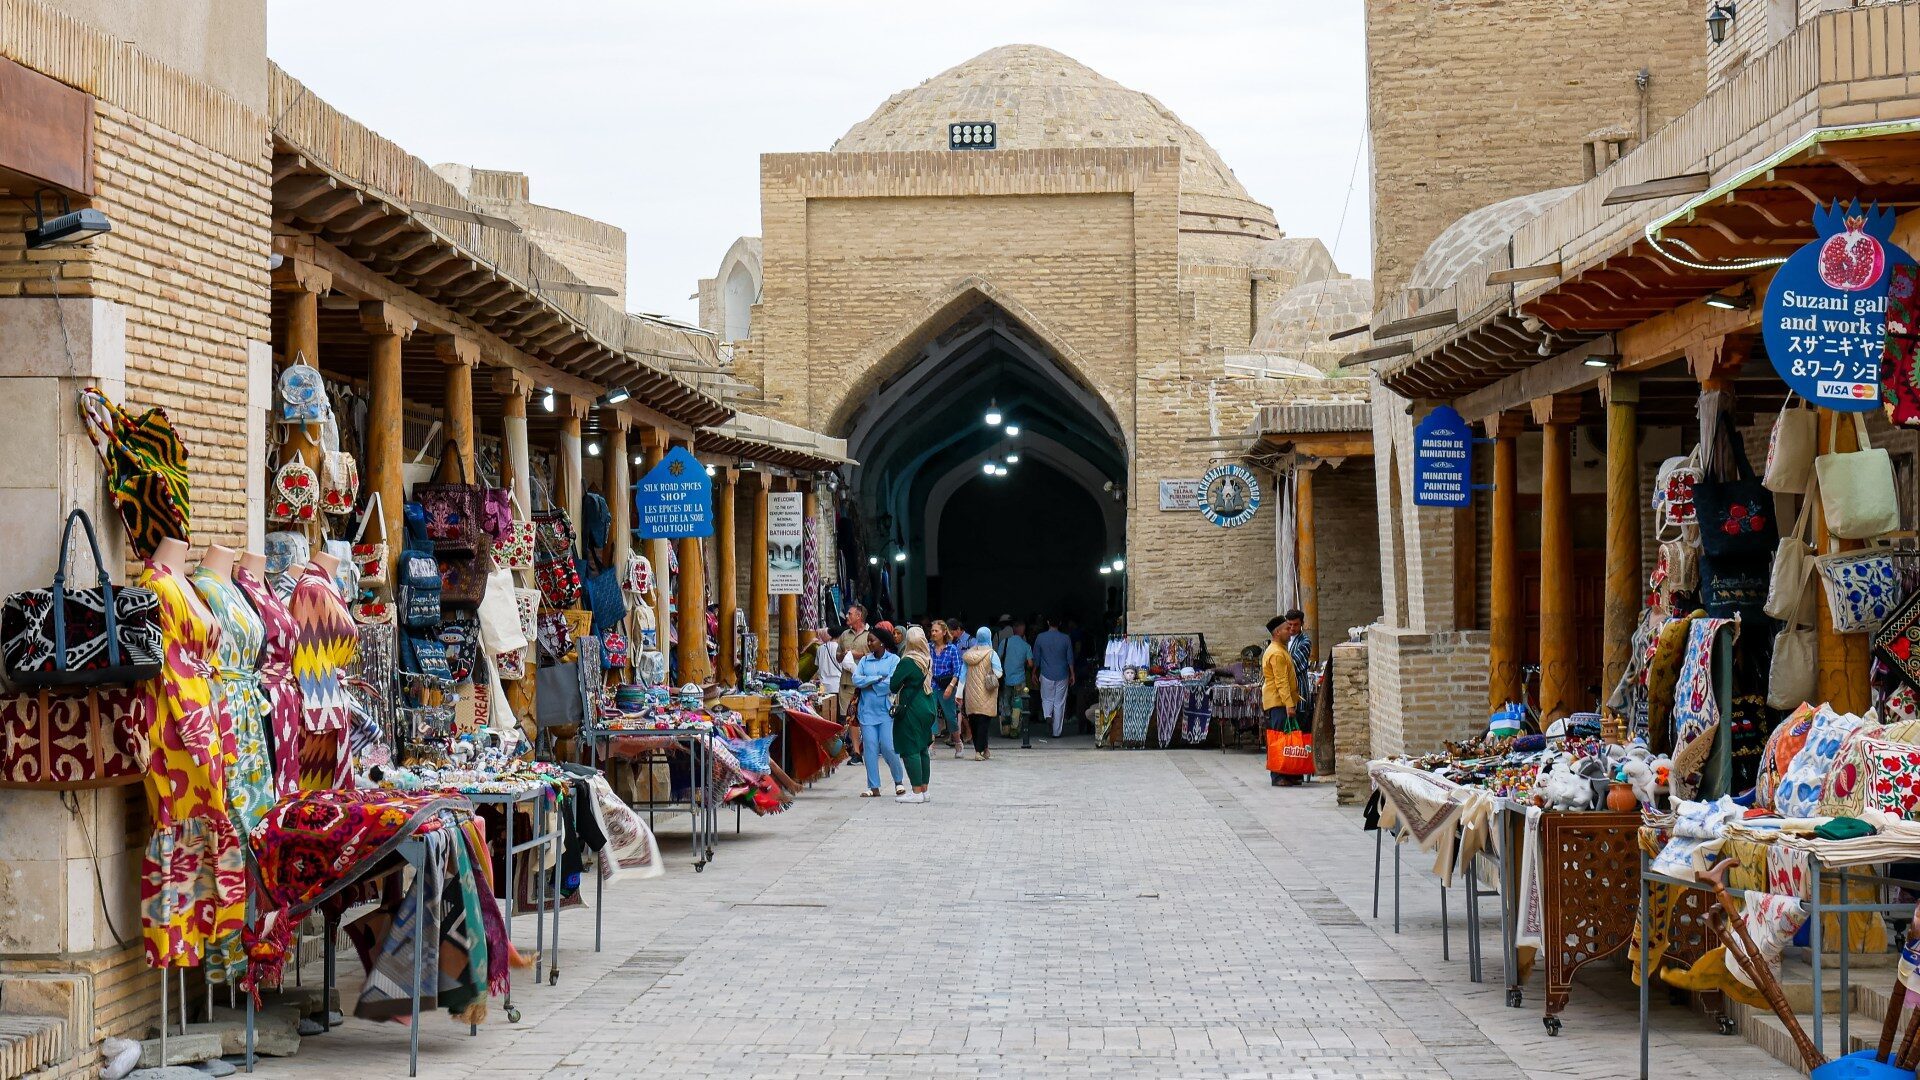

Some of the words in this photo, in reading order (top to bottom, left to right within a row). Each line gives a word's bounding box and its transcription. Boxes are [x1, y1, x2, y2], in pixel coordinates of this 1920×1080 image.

[1782, 290, 1848, 311] Suzani
[1780, 314, 1817, 331] and
[1822, 318, 1872, 335] work
[1822, 384, 1849, 396] VISA
[1422, 439, 1452, 448] MAISON
[1453, 440, 1464, 449] DE
[1419, 449, 1466, 459] MINIATURES
[1422, 471, 1463, 480] MINATURE
[643, 483, 659, 492] SILK
[660, 482, 679, 491] ROAD
[680, 482, 702, 490] SPICES
[1232, 465, 1260, 501] WORKSHOP
[1424, 482, 1461, 491] PAINTING
[660, 492, 687, 501] SHOP
[1419, 492, 1466, 501] WORKSHOP
[644, 505, 657, 514] LES
[658, 504, 682, 513] EPICES
[683, 503, 693, 512] DE
[694, 503, 703, 512] LA
[644, 514, 668, 524] ROUTE
[669, 514, 679, 523] DE
[680, 514, 688, 522] LA
[689, 513, 704, 522] SOIE
[1201, 506, 1218, 523] AND
[1222, 503, 1260, 527] MUZEUM
[652, 523, 695, 534] BOUTIQUE
